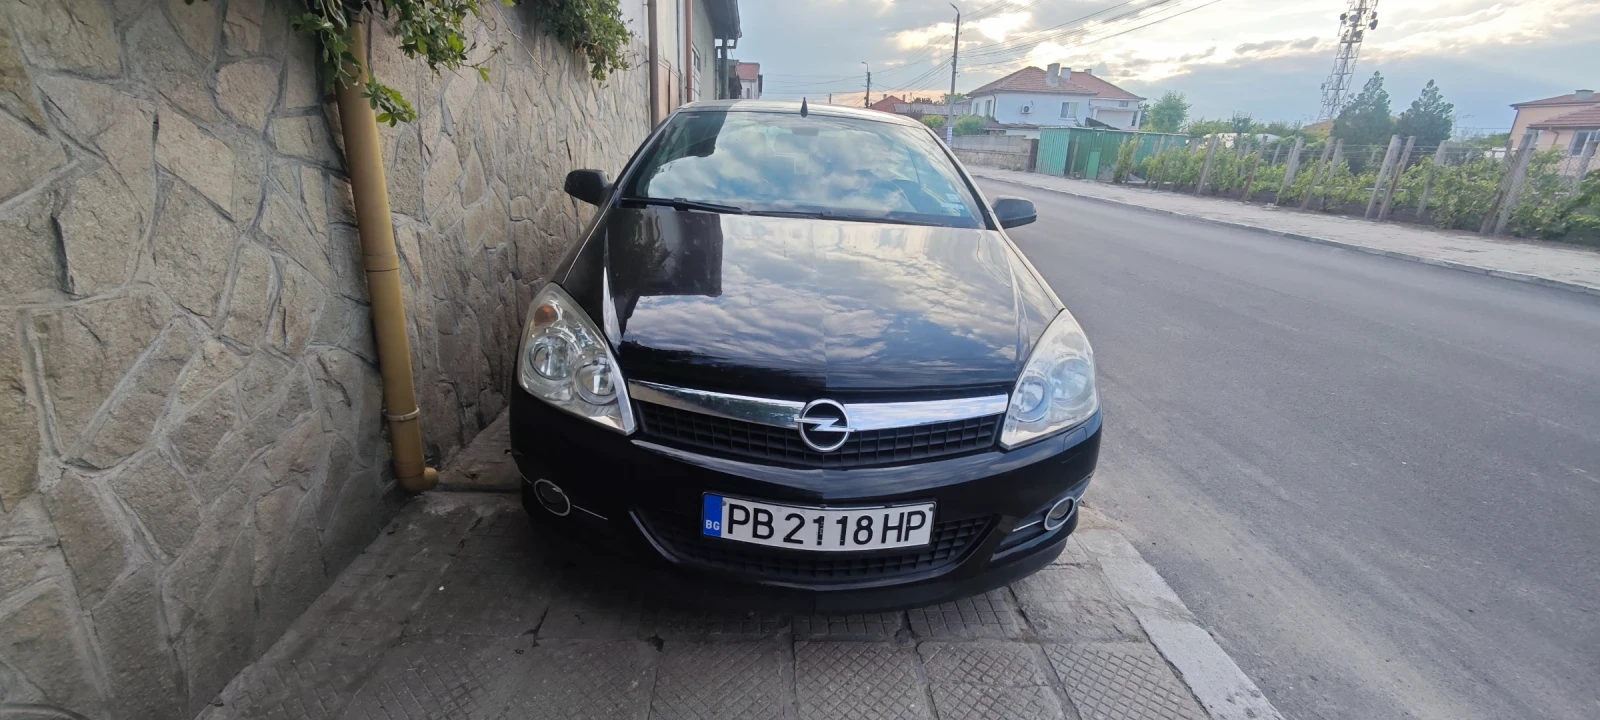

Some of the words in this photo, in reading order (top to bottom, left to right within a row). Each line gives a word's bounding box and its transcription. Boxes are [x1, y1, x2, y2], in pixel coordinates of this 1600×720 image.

[705, 519, 720, 531] BG
[727, 503, 775, 540] PB
[783, 513, 874, 546] 2118
[880, 510, 927, 544] HP
